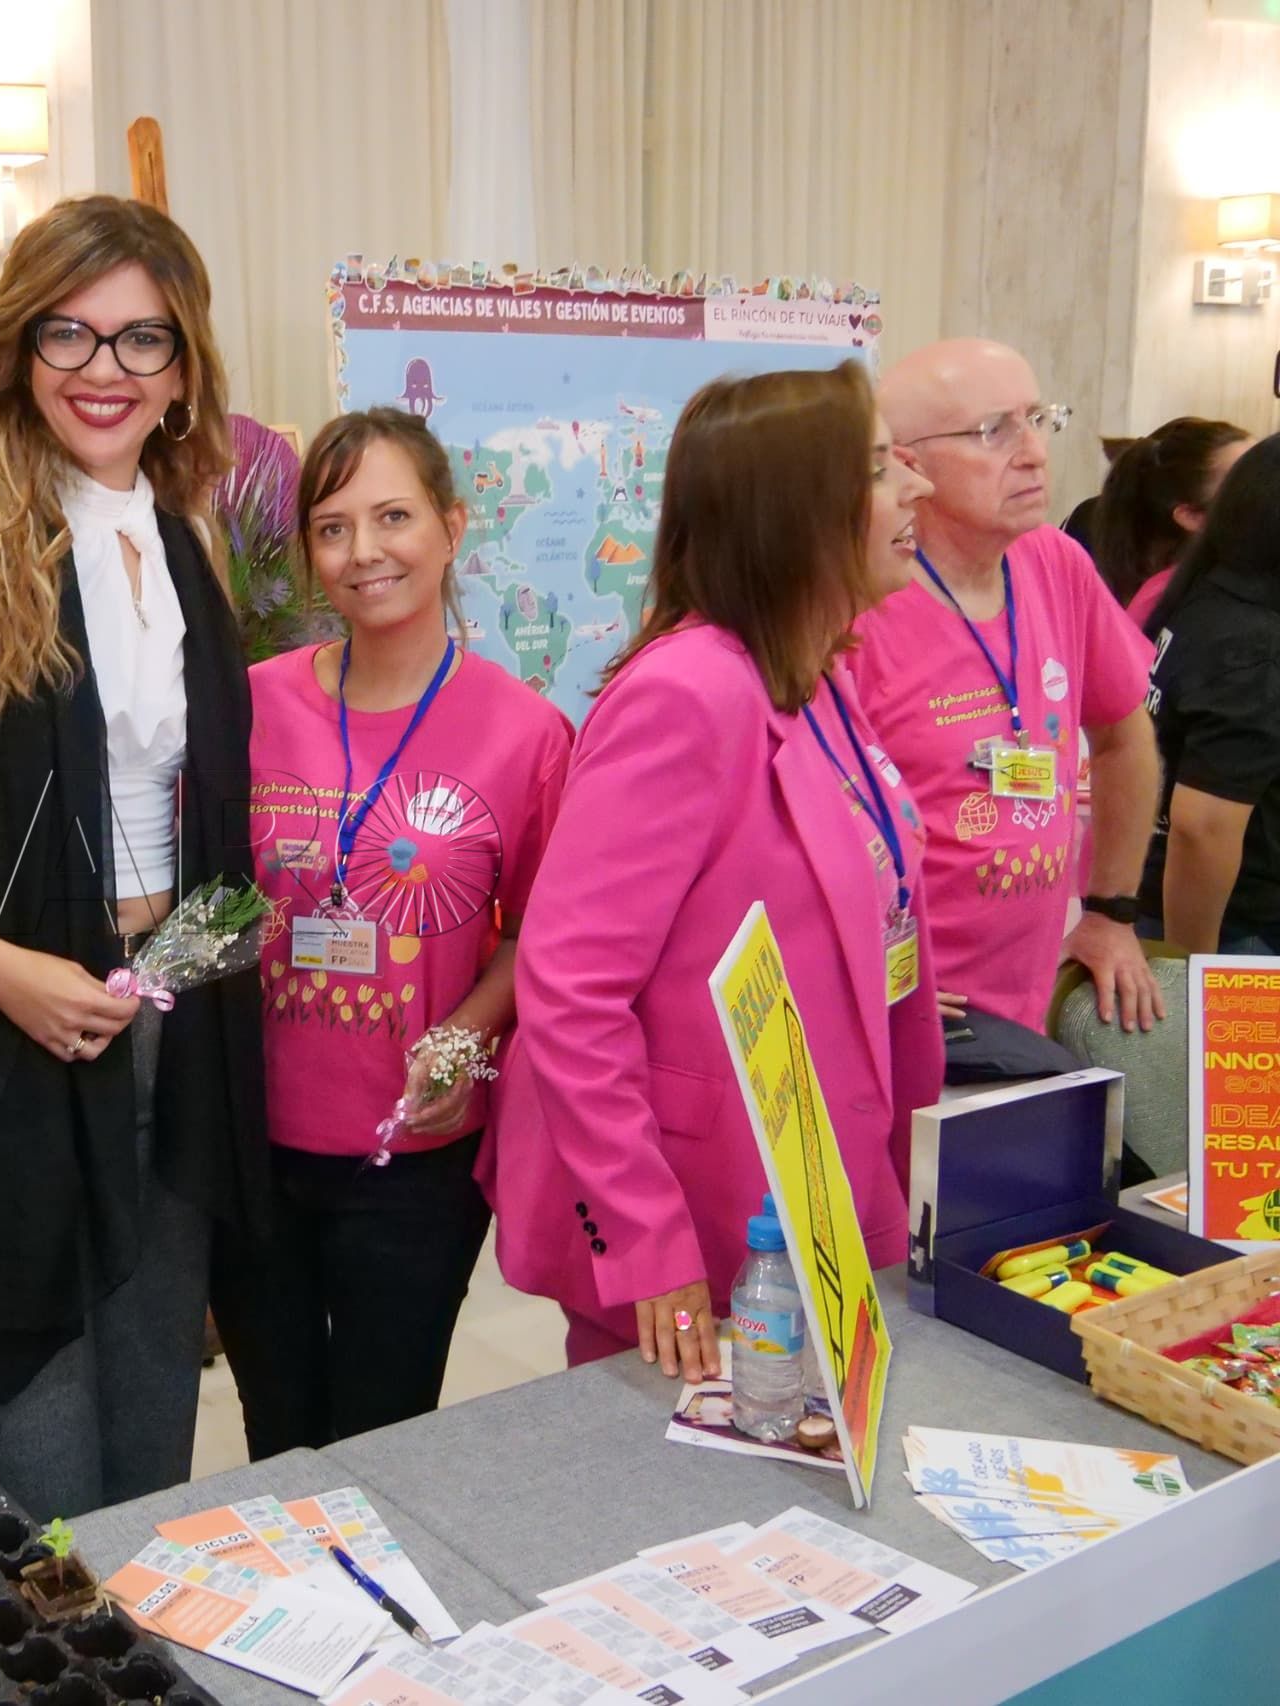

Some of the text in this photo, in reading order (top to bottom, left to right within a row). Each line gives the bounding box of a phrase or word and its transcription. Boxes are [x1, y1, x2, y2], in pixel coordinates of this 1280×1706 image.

[359, 294, 685, 325] C.F.S. AGENCIAS DE VIAJES Y GESTIÓN DE EVENTOS
[713, 307, 848, 327] EL RINCÓN DE TU VIAJE
[331, 955, 348, 965] FP
[1207, 1020, 1280, 1043] CRE
[1211, 1162, 1248, 1178] TU
[733, 1312, 768, 1333] ZOYA
[195, 1532, 249, 1552] CICLOS
[137, 1581, 179, 1614] CICLOS
[221, 1615, 260, 1647] MELILLA
